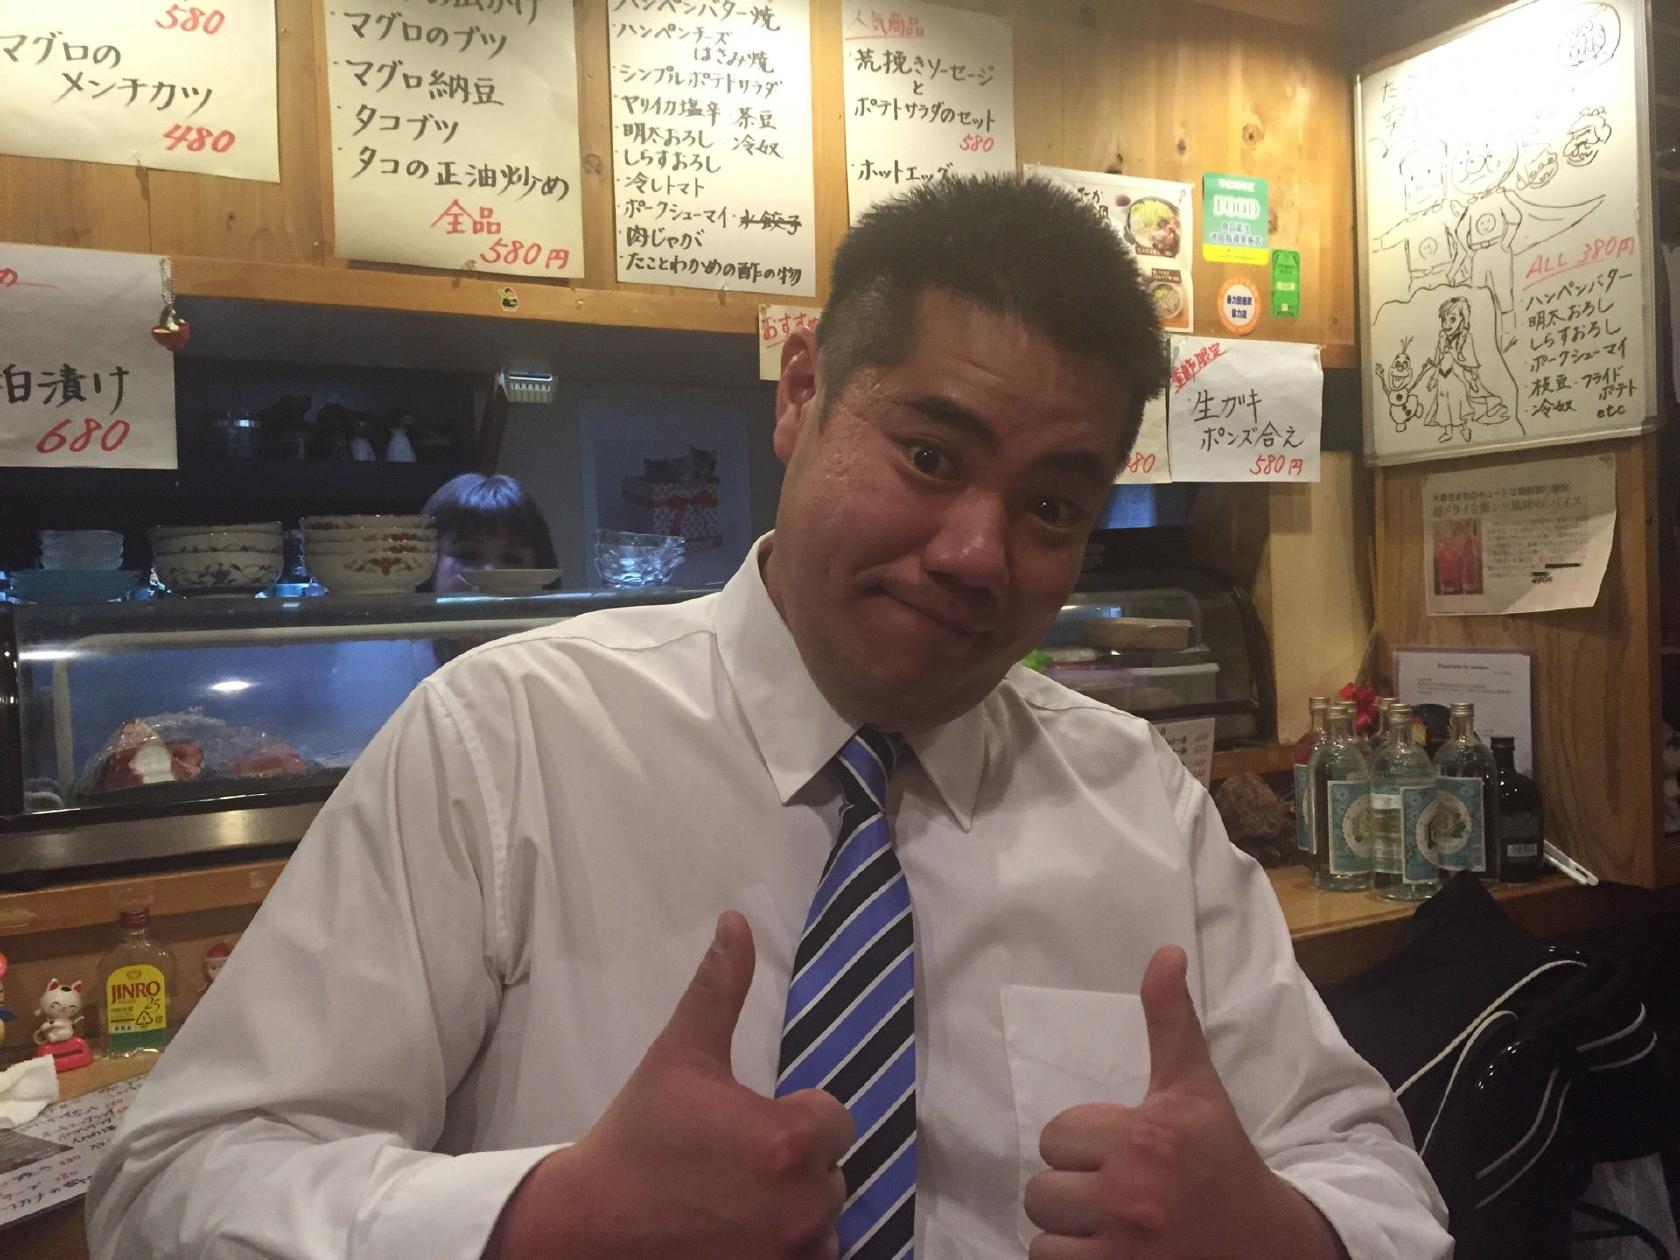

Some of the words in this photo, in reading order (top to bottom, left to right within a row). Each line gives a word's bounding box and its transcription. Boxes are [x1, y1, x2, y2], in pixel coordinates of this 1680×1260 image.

[155, 4, 225, 34] 580
[617, 23, 733, 45] ハンペンチーズ
[851, 10, 924, 37] 人気商品
[0, 31, 121, 68] マグロの
[344, 12, 507, 60] マグロのブツ
[694, 47, 774, 73] はさみ焼
[855, 48, 994, 86] 荒挽きソーセージ
[53, 71, 212, 119] メンチカツ
[346, 59, 504, 106] マグロ納豆
[913, 80, 924, 95] と
[352, 104, 459, 143] タコブツ
[736, 107, 777, 130] 茶豆
[855, 98, 995, 132] ポテトサラダのセット
[163, 123, 235, 153] 480
[623, 122, 714, 148] 明太おろし
[733, 134, 784, 159] 冷奴
[960, 134, 994, 152] 580
[352, 146, 569, 202] タコの正油炒め
[625, 149, 721, 173] しらすおろし
[625, 171, 704, 197] 冷しトマト
[430, 199, 502, 234] 全品
[624, 199, 727, 228] ポークシューマイ
[627, 225, 704, 250] 肉じゃが
[480, 238, 569, 269] 580円
[1526, 253, 1568, 278] ALL
[626, 252, 801, 286] たことわかめの酢の物
[1526, 269, 1632, 310] ハンペンバター
[1528, 298, 1614, 330] 明太おろし
[1531, 319, 1621, 351] しらすおろし
[1531, 337, 1627, 371] ポークシューマイ
[1529, 374, 1571, 398] 枝豆
[1582, 366, 1623, 388] フライド
[1599, 379, 1637, 400] ポテト
[1192, 388, 1263, 423] 生ガキ
[1531, 399, 1576, 418] 冷奴
[1597, 405, 1627, 418] etc
[36, 418, 130, 453] 680
[1201, 421, 1305, 451] ポンズ合え
[1127, 452, 1155, 473] 80
[1250, 455, 1303, 475] 580円
[111, 981, 160, 1005] JINRO
